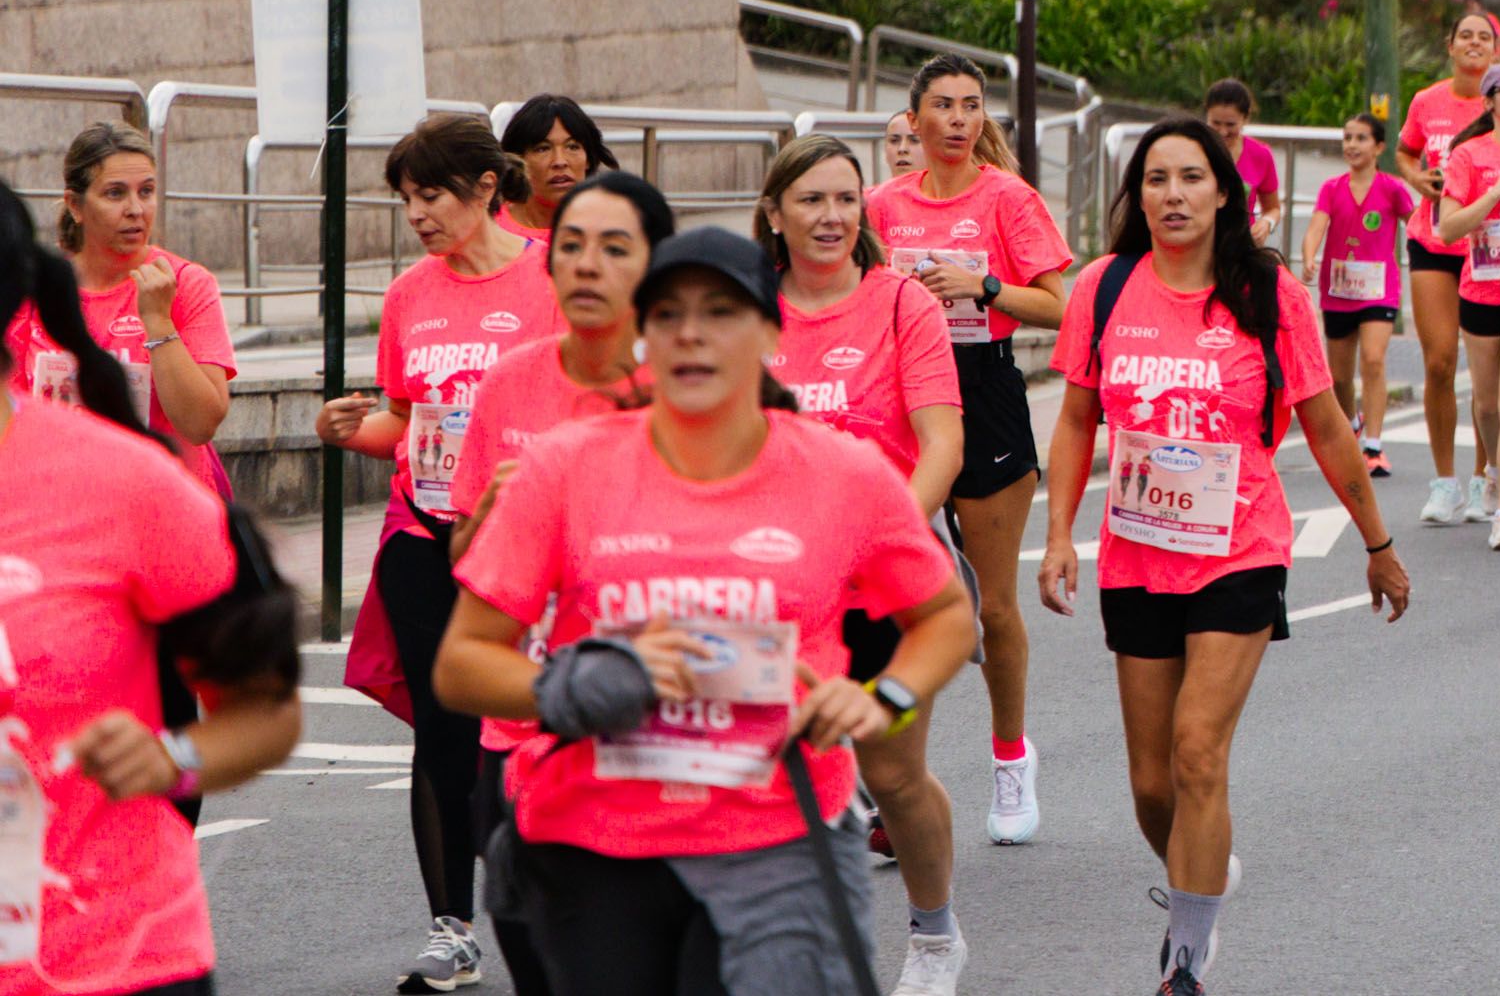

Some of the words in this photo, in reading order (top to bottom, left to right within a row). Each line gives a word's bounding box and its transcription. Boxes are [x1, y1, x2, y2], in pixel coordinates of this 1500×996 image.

[889, 225, 926, 237] OYSHO
[1109, 355, 1223, 391] CARRERA
[1148, 487, 1194, 510] 016
[1121, 523, 1156, 538] OYSHO
